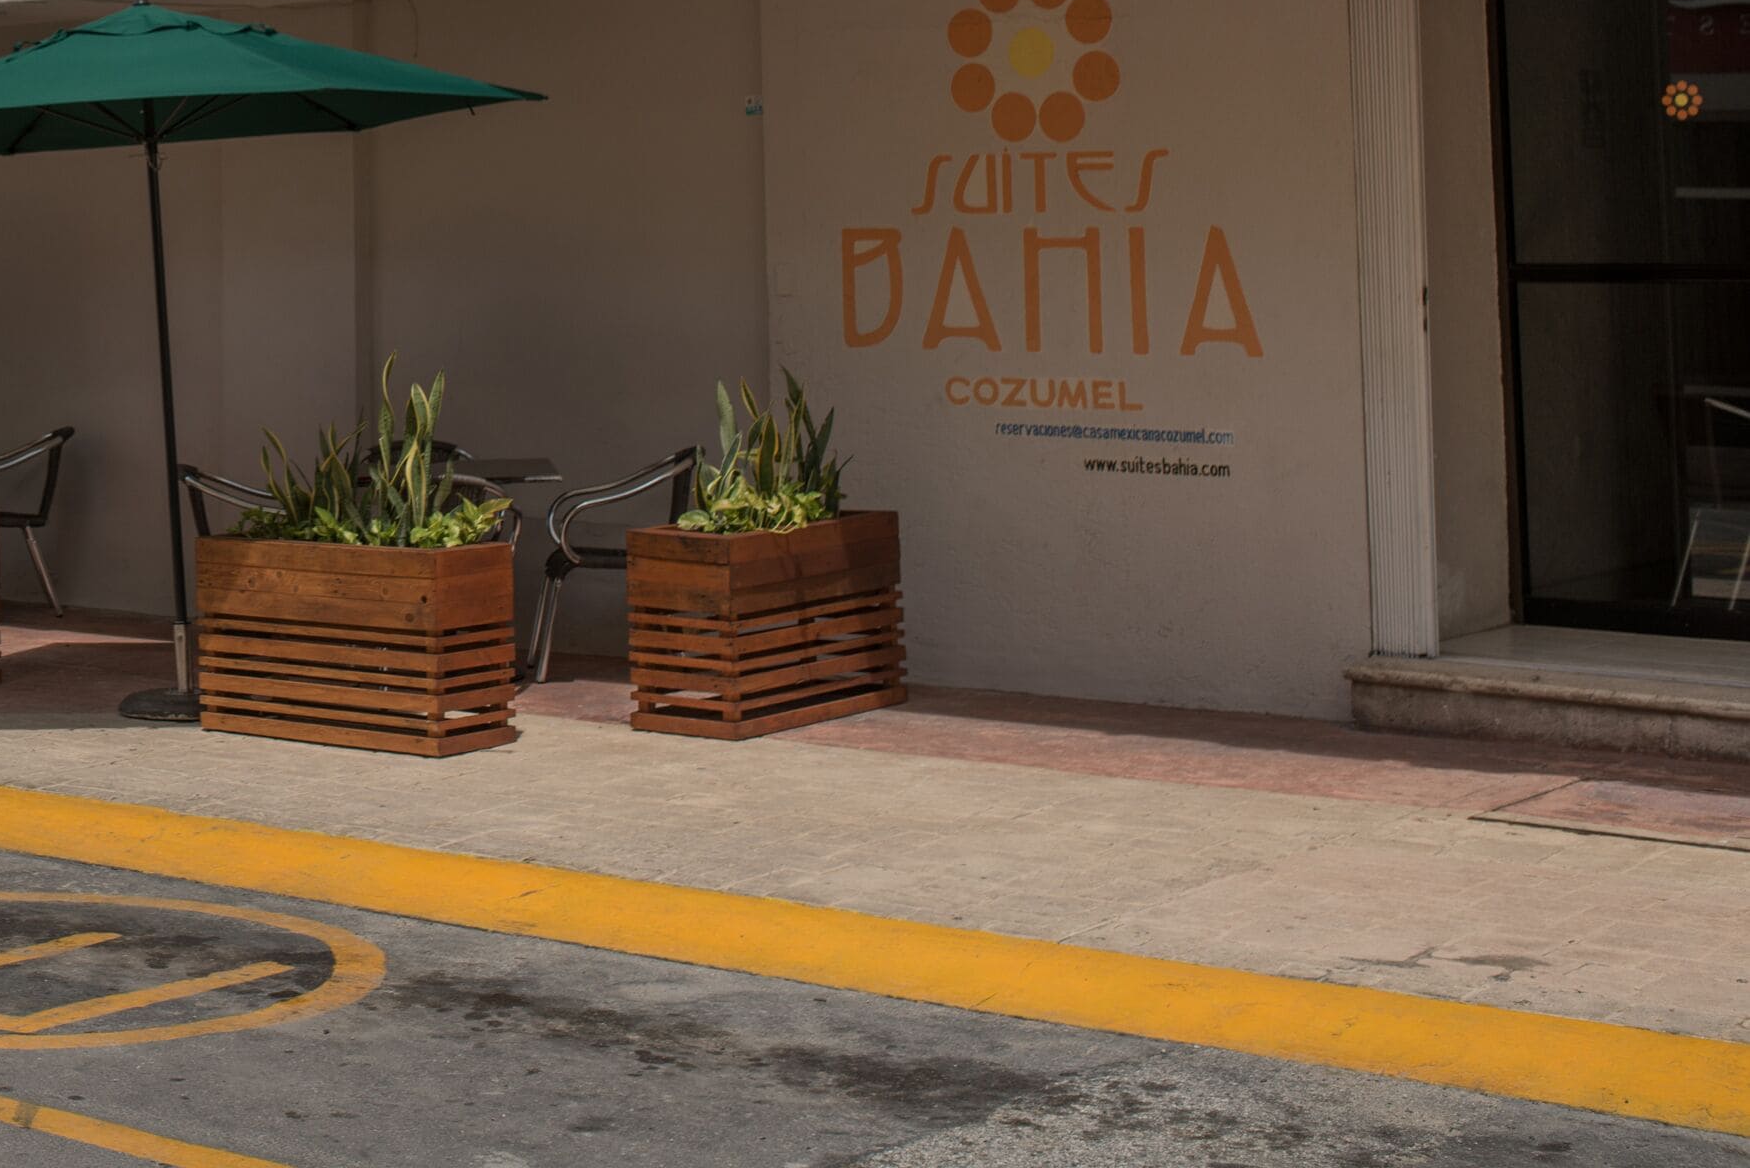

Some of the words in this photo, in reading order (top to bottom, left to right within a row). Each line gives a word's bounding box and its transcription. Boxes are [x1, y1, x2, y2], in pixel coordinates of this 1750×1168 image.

[911, 146, 1169, 215] SUITES
[840, 224, 1264, 358] BAHIA
[944, 376, 1144, 412] COZUMEL
[1083, 456, 1231, 478] www.suitesbahia.com
